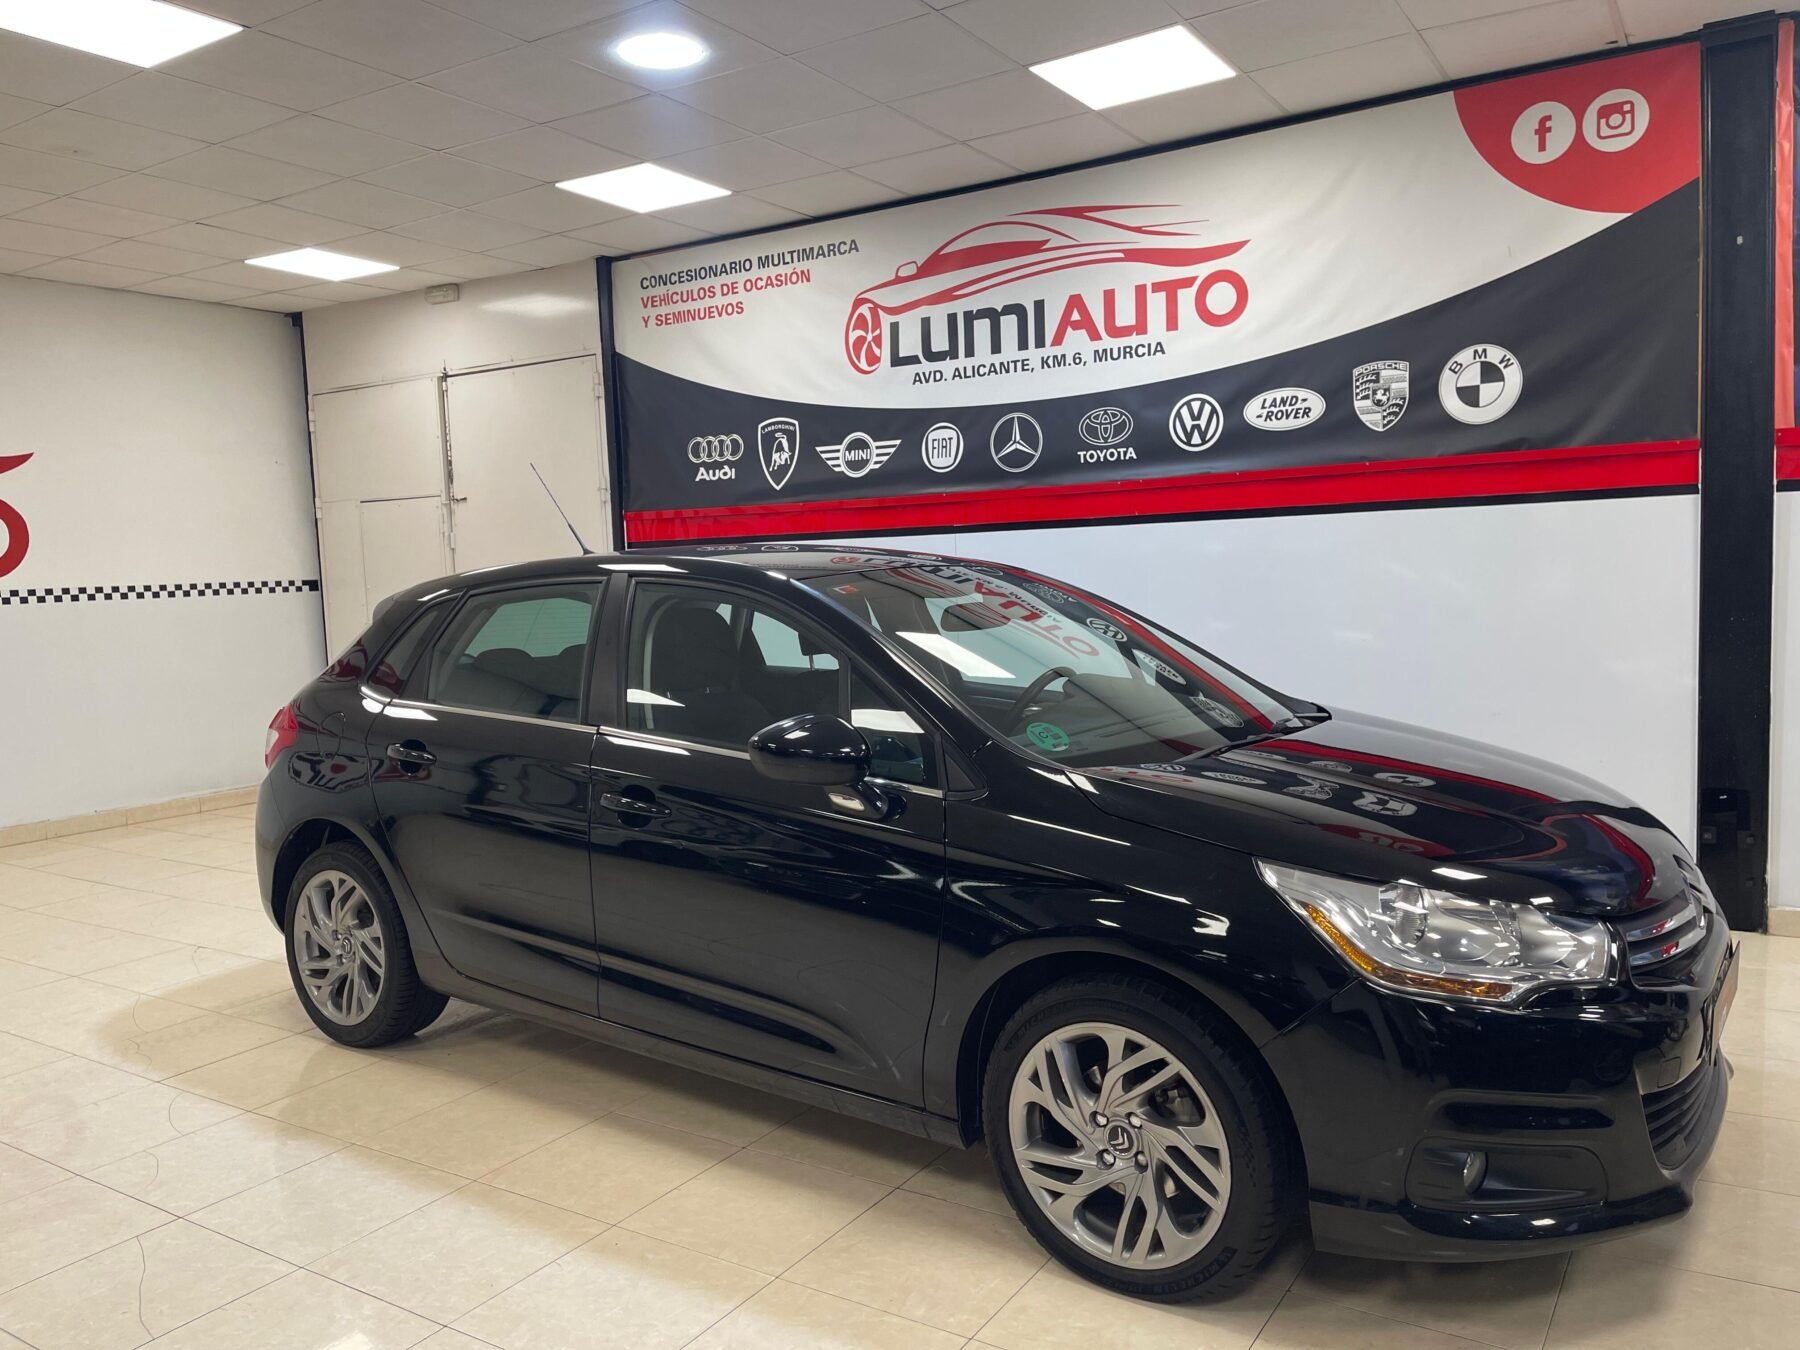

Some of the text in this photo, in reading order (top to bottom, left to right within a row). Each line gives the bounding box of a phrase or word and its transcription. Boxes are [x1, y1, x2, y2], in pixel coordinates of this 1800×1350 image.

[640, 239, 860, 290] CONCESIONARIO MULTIMARCA
[641, 268, 811, 308] VEHÍCULOS DE OCASIÓN
[642, 301, 744, 328] Y SEMINUEVOS
[912, 341, 1166, 385] AVD. ALICANTE, KM.6, MURCIA
[1354, 361, 1408, 377] PORSCHE
[1448, 348, 1514, 375] BMW
[761, 424, 796, 434] LAMBORGHINI
[844, 449, 871, 462] MINI
[931, 437, 954, 459] FIAT
[1077, 447, 1137, 464] TOYOTA
[695, 466, 736, 482] Audi
